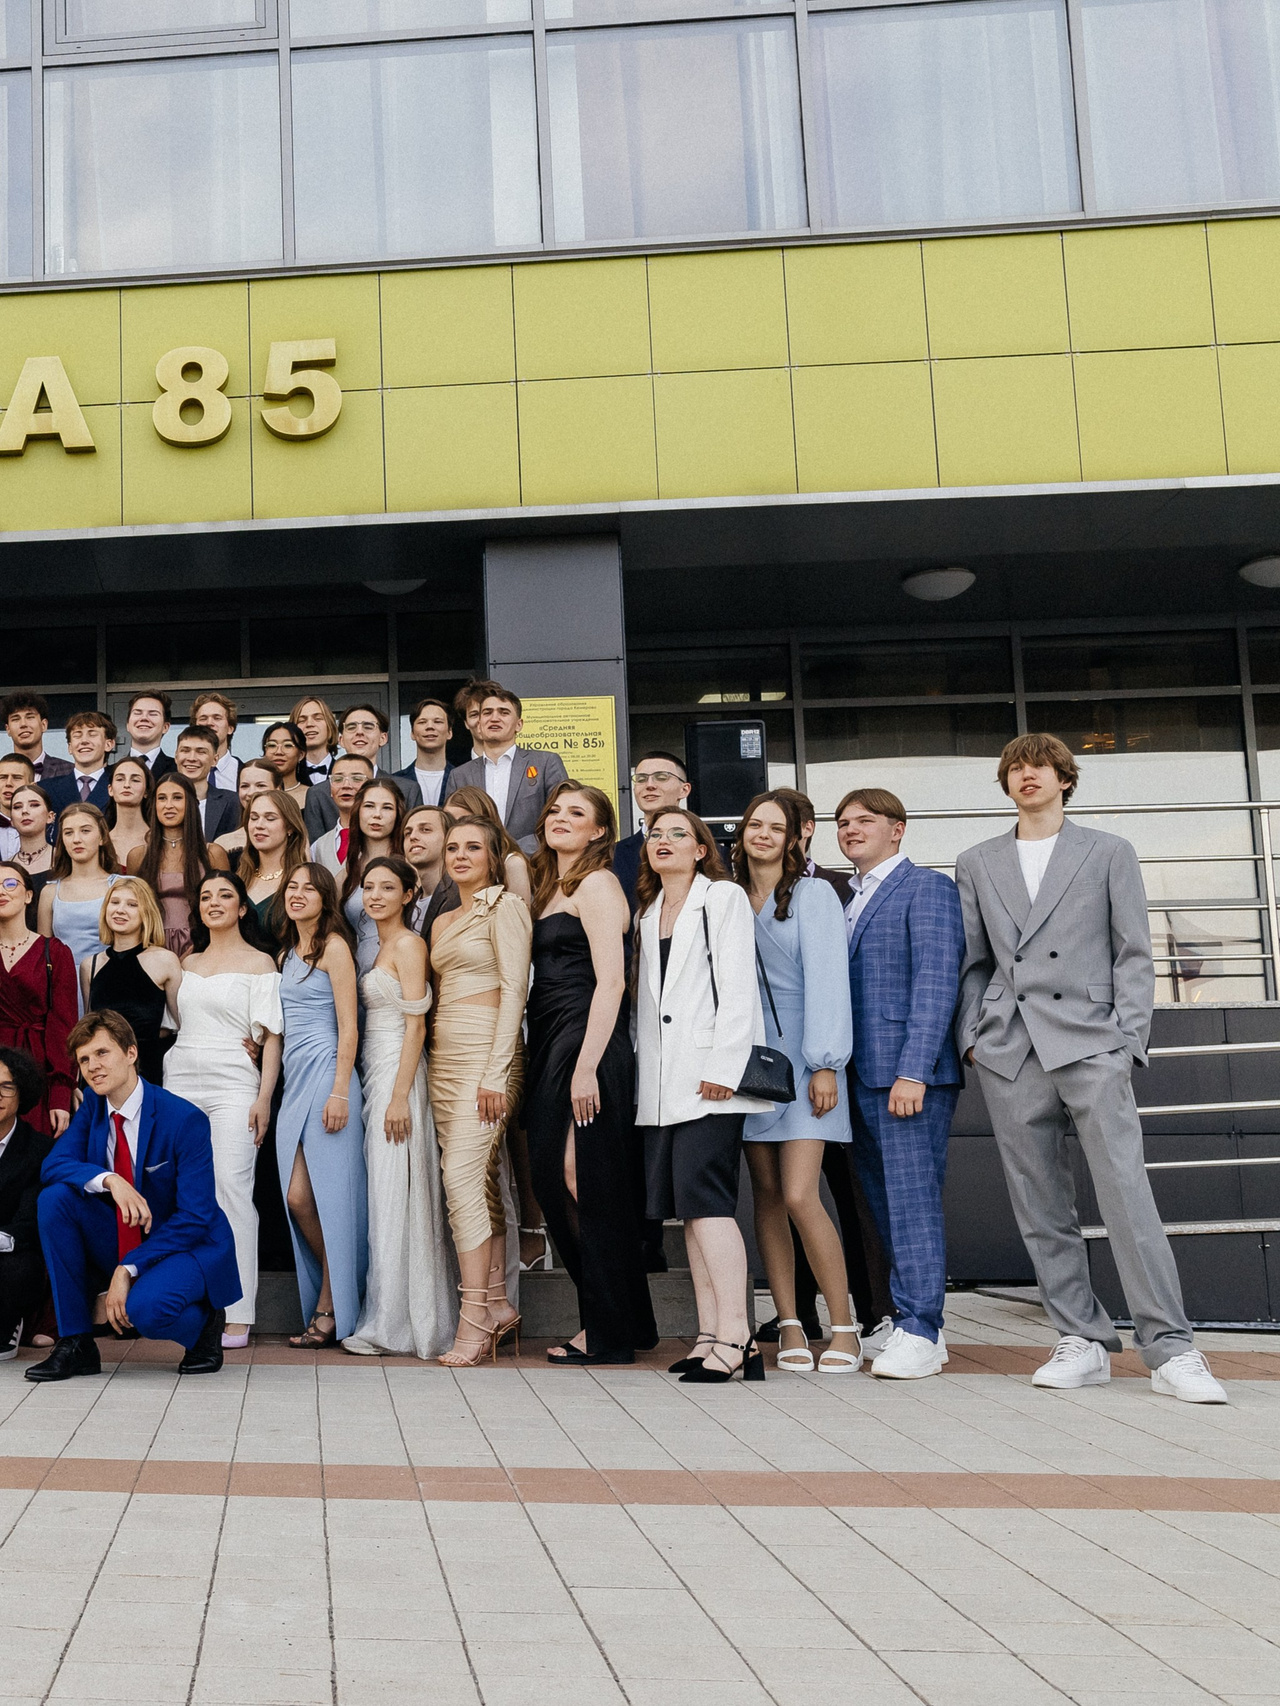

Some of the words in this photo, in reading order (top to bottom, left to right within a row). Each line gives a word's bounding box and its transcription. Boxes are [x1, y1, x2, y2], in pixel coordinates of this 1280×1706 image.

[152, 338, 342, 448] 85
[539, 724, 576, 732] «Средняя
[582, 738, 605, 748] 85»
